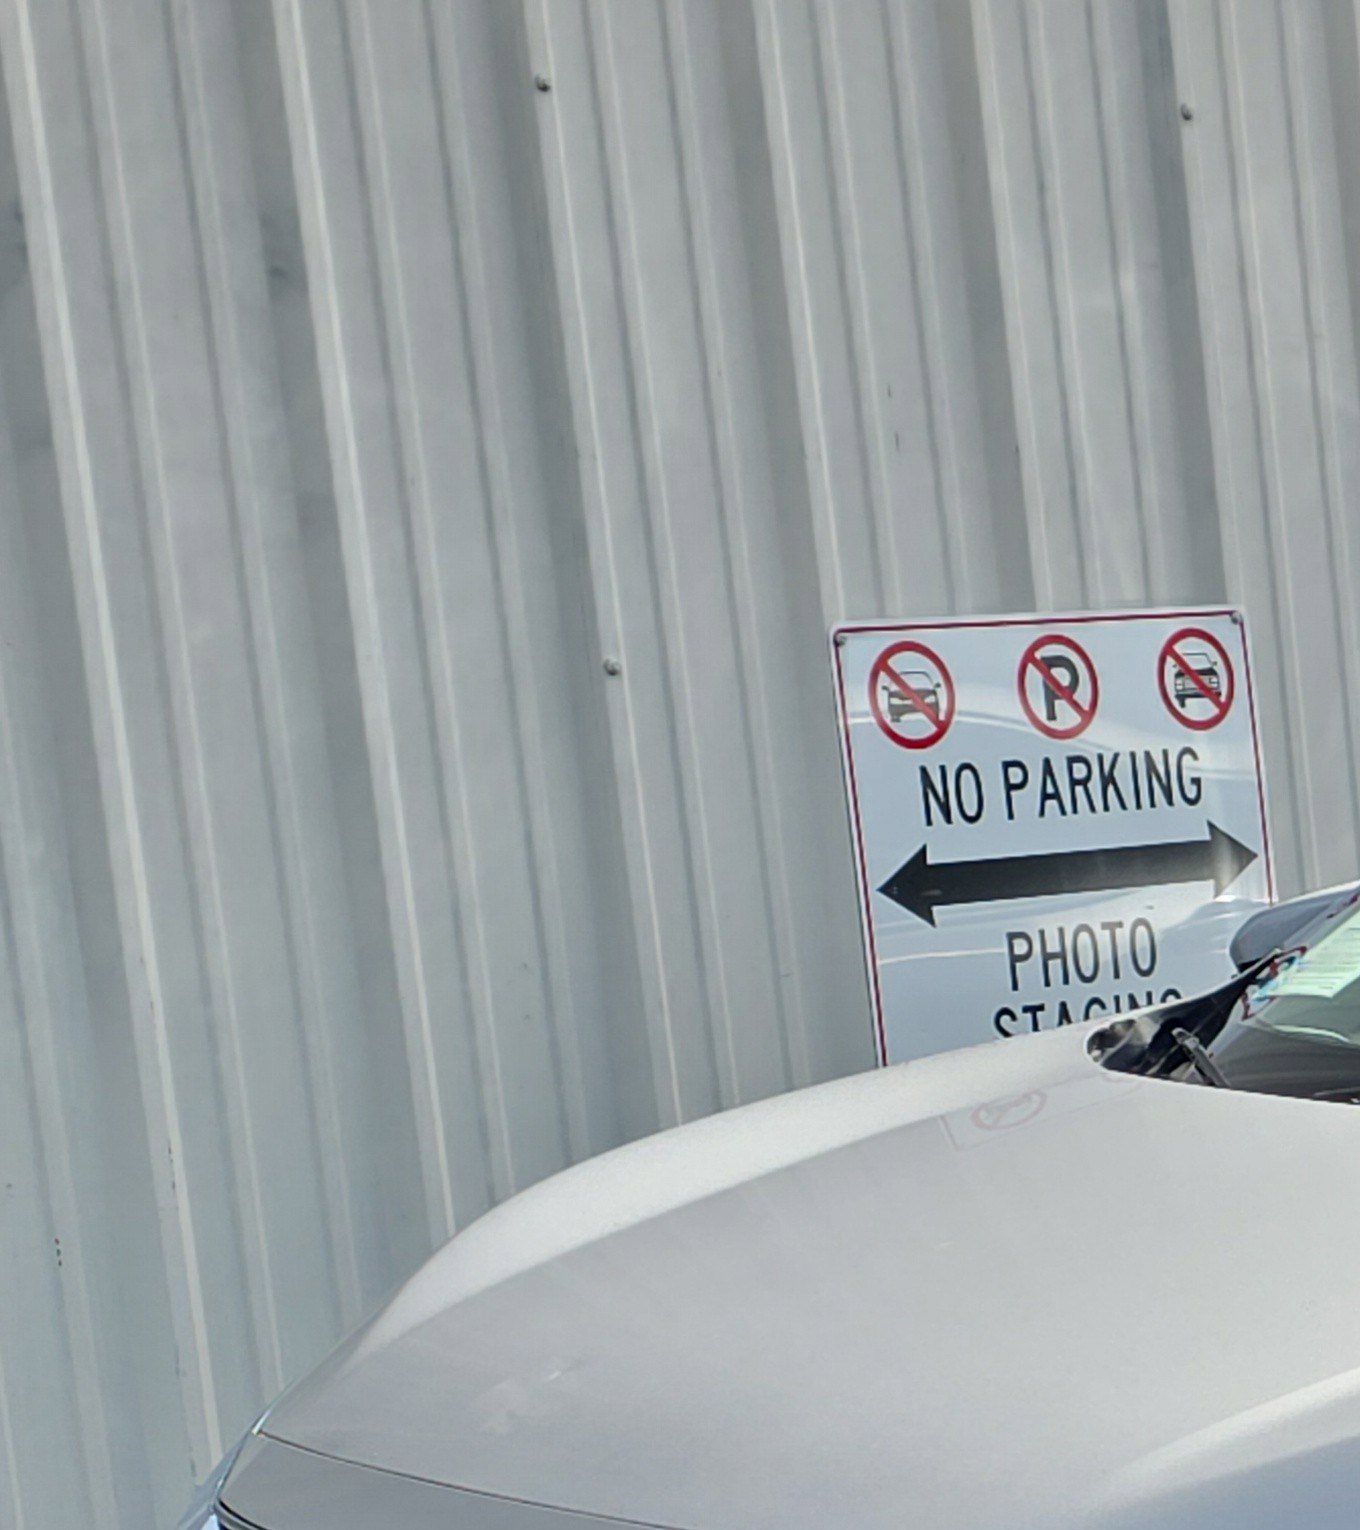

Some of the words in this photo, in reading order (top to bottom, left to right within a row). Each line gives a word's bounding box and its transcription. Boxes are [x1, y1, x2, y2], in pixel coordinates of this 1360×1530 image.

[919, 762, 984, 827] NO
[1002, 746, 1201, 820] PARKING
[1006, 917, 1157, 991] PHOTO
